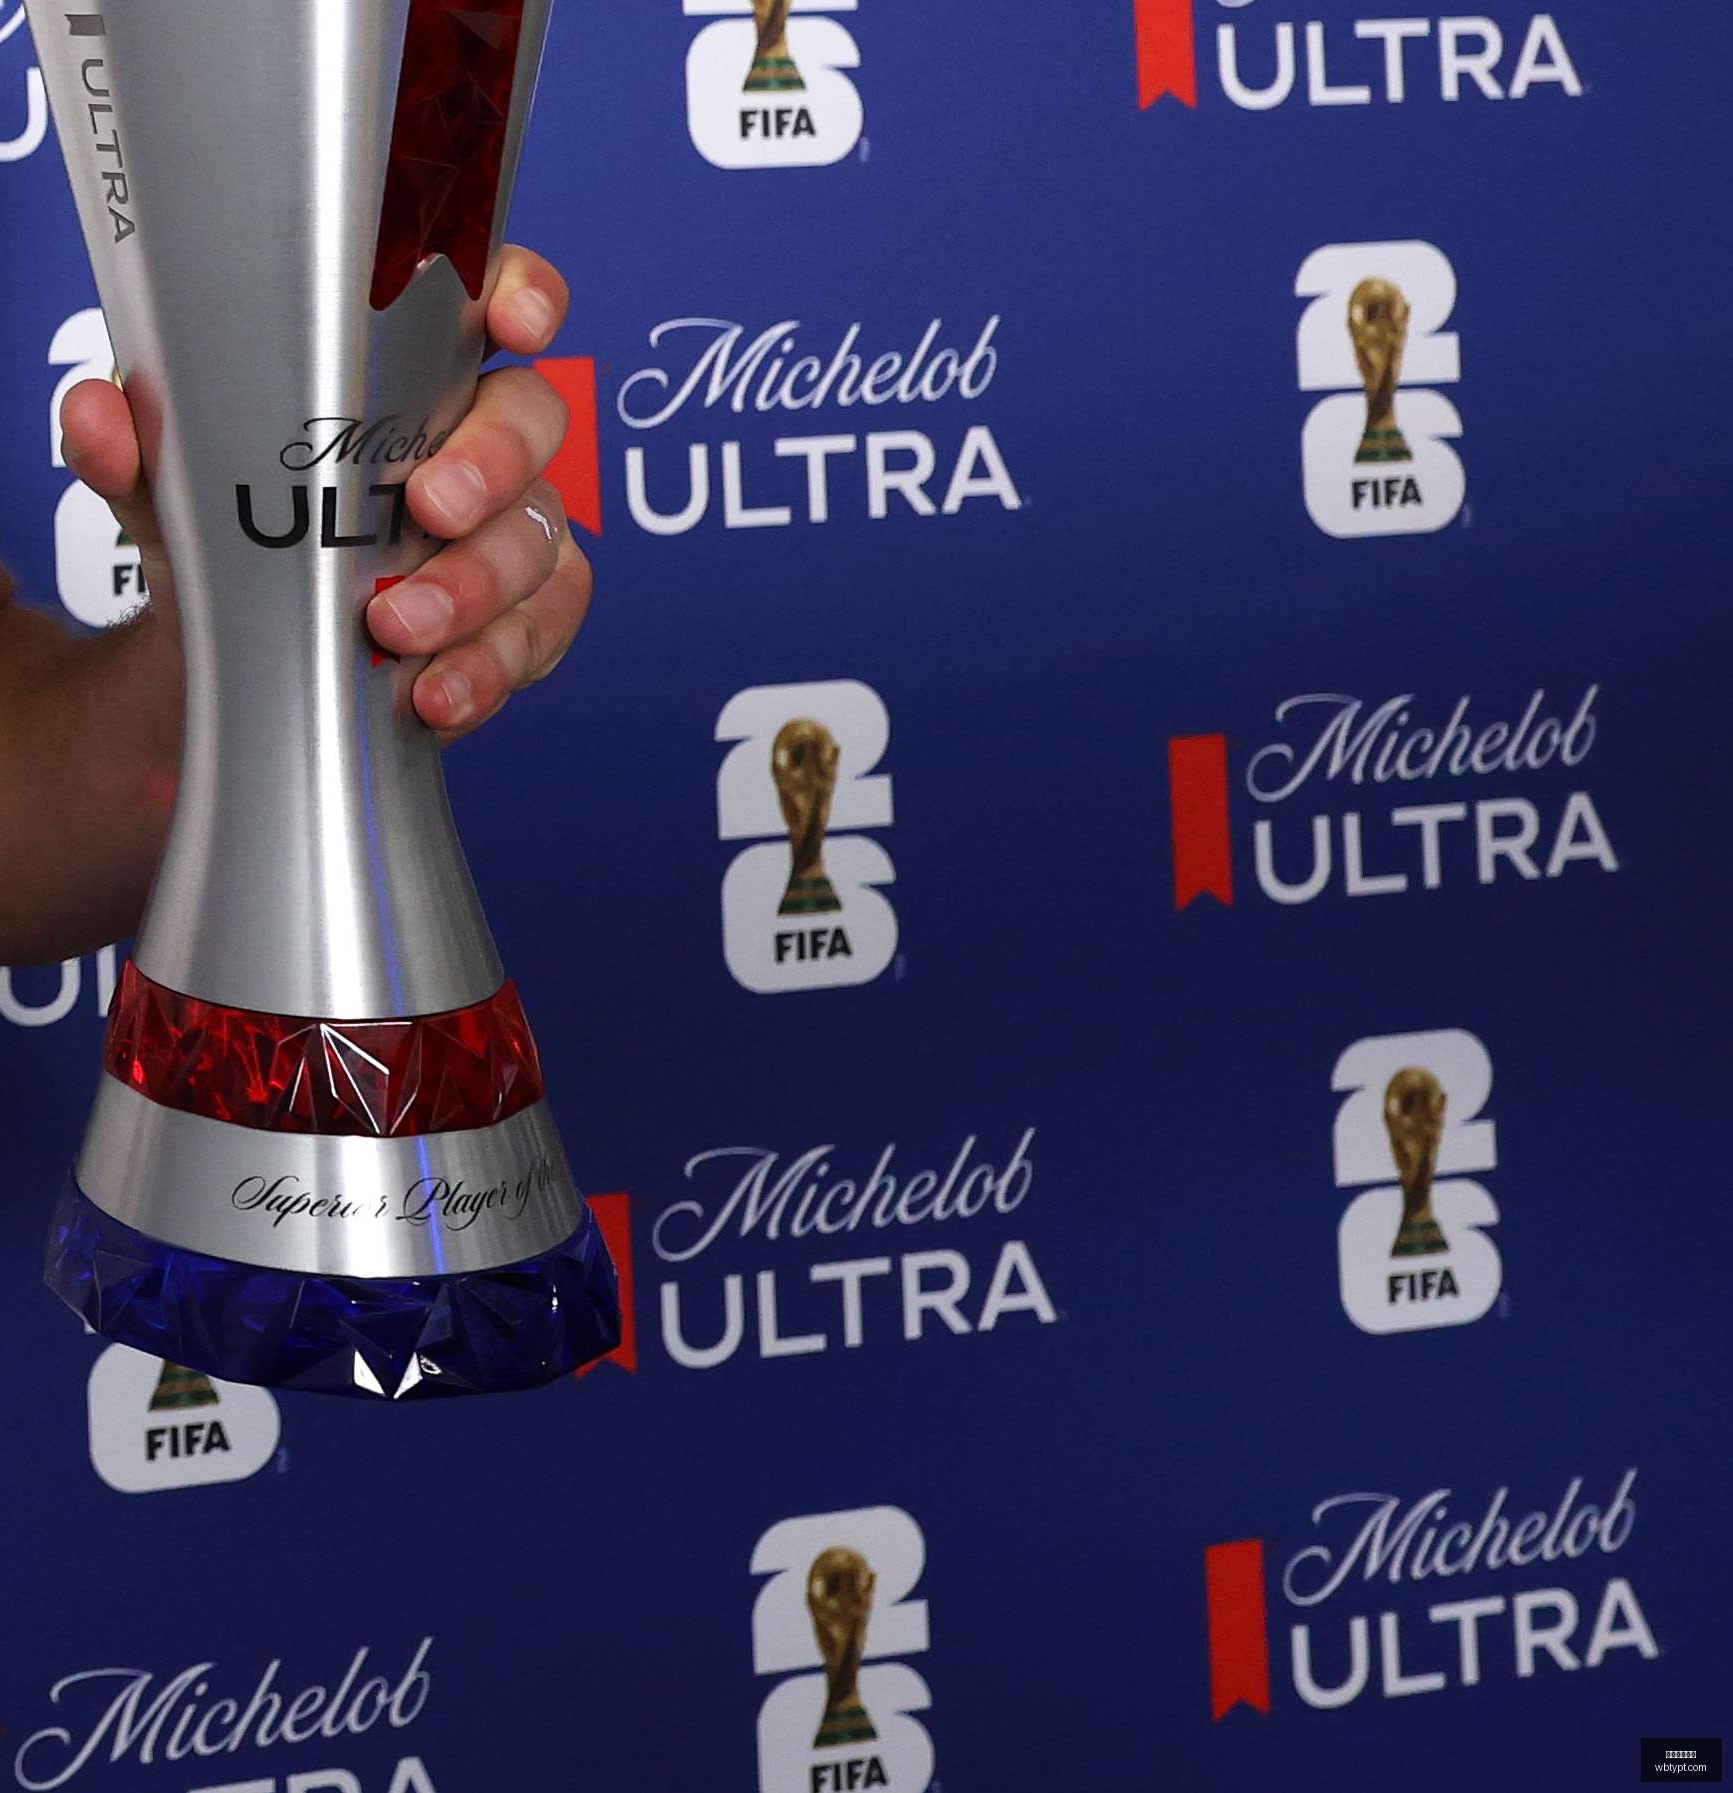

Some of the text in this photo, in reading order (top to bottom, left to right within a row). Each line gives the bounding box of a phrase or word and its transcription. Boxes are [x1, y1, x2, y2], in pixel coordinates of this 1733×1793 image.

[1217, 15, 1581, 110] ULTRA
[80, 58, 136, 245] ULTRA
[741, 108, 815, 137] FIFA
[618, 315, 999, 428] Michelob
[280, 416, 448, 471] Miche
[626, 426, 1021, 534] ULTRA
[235, 483, 407, 549] ULT
[1352, 478, 1421, 507] FIFA
[112, 563, 146, 596] FI
[1247, 685, 1597, 801] Michelob
[1255, 792, 1618, 903] ULTRA
[776, 928, 851, 962] FIFA
[231, 1175, 390, 1228] Superir
[395, 1176, 507, 1232] Player
[654, 1128, 1034, 1261] Michelob
[661, 1241, 1056, 1368] ULTRA
[1389, 1270, 1458, 1302] FIFA
[147, 1422, 229, 1460] FIFA
[1284, 1470, 1635, 1605] Michelob
[1292, 1579, 1658, 1708] ULTRA
[15, 1638, 431, 1790] Michelob
[810, 1756, 887, 1793] FIFA
